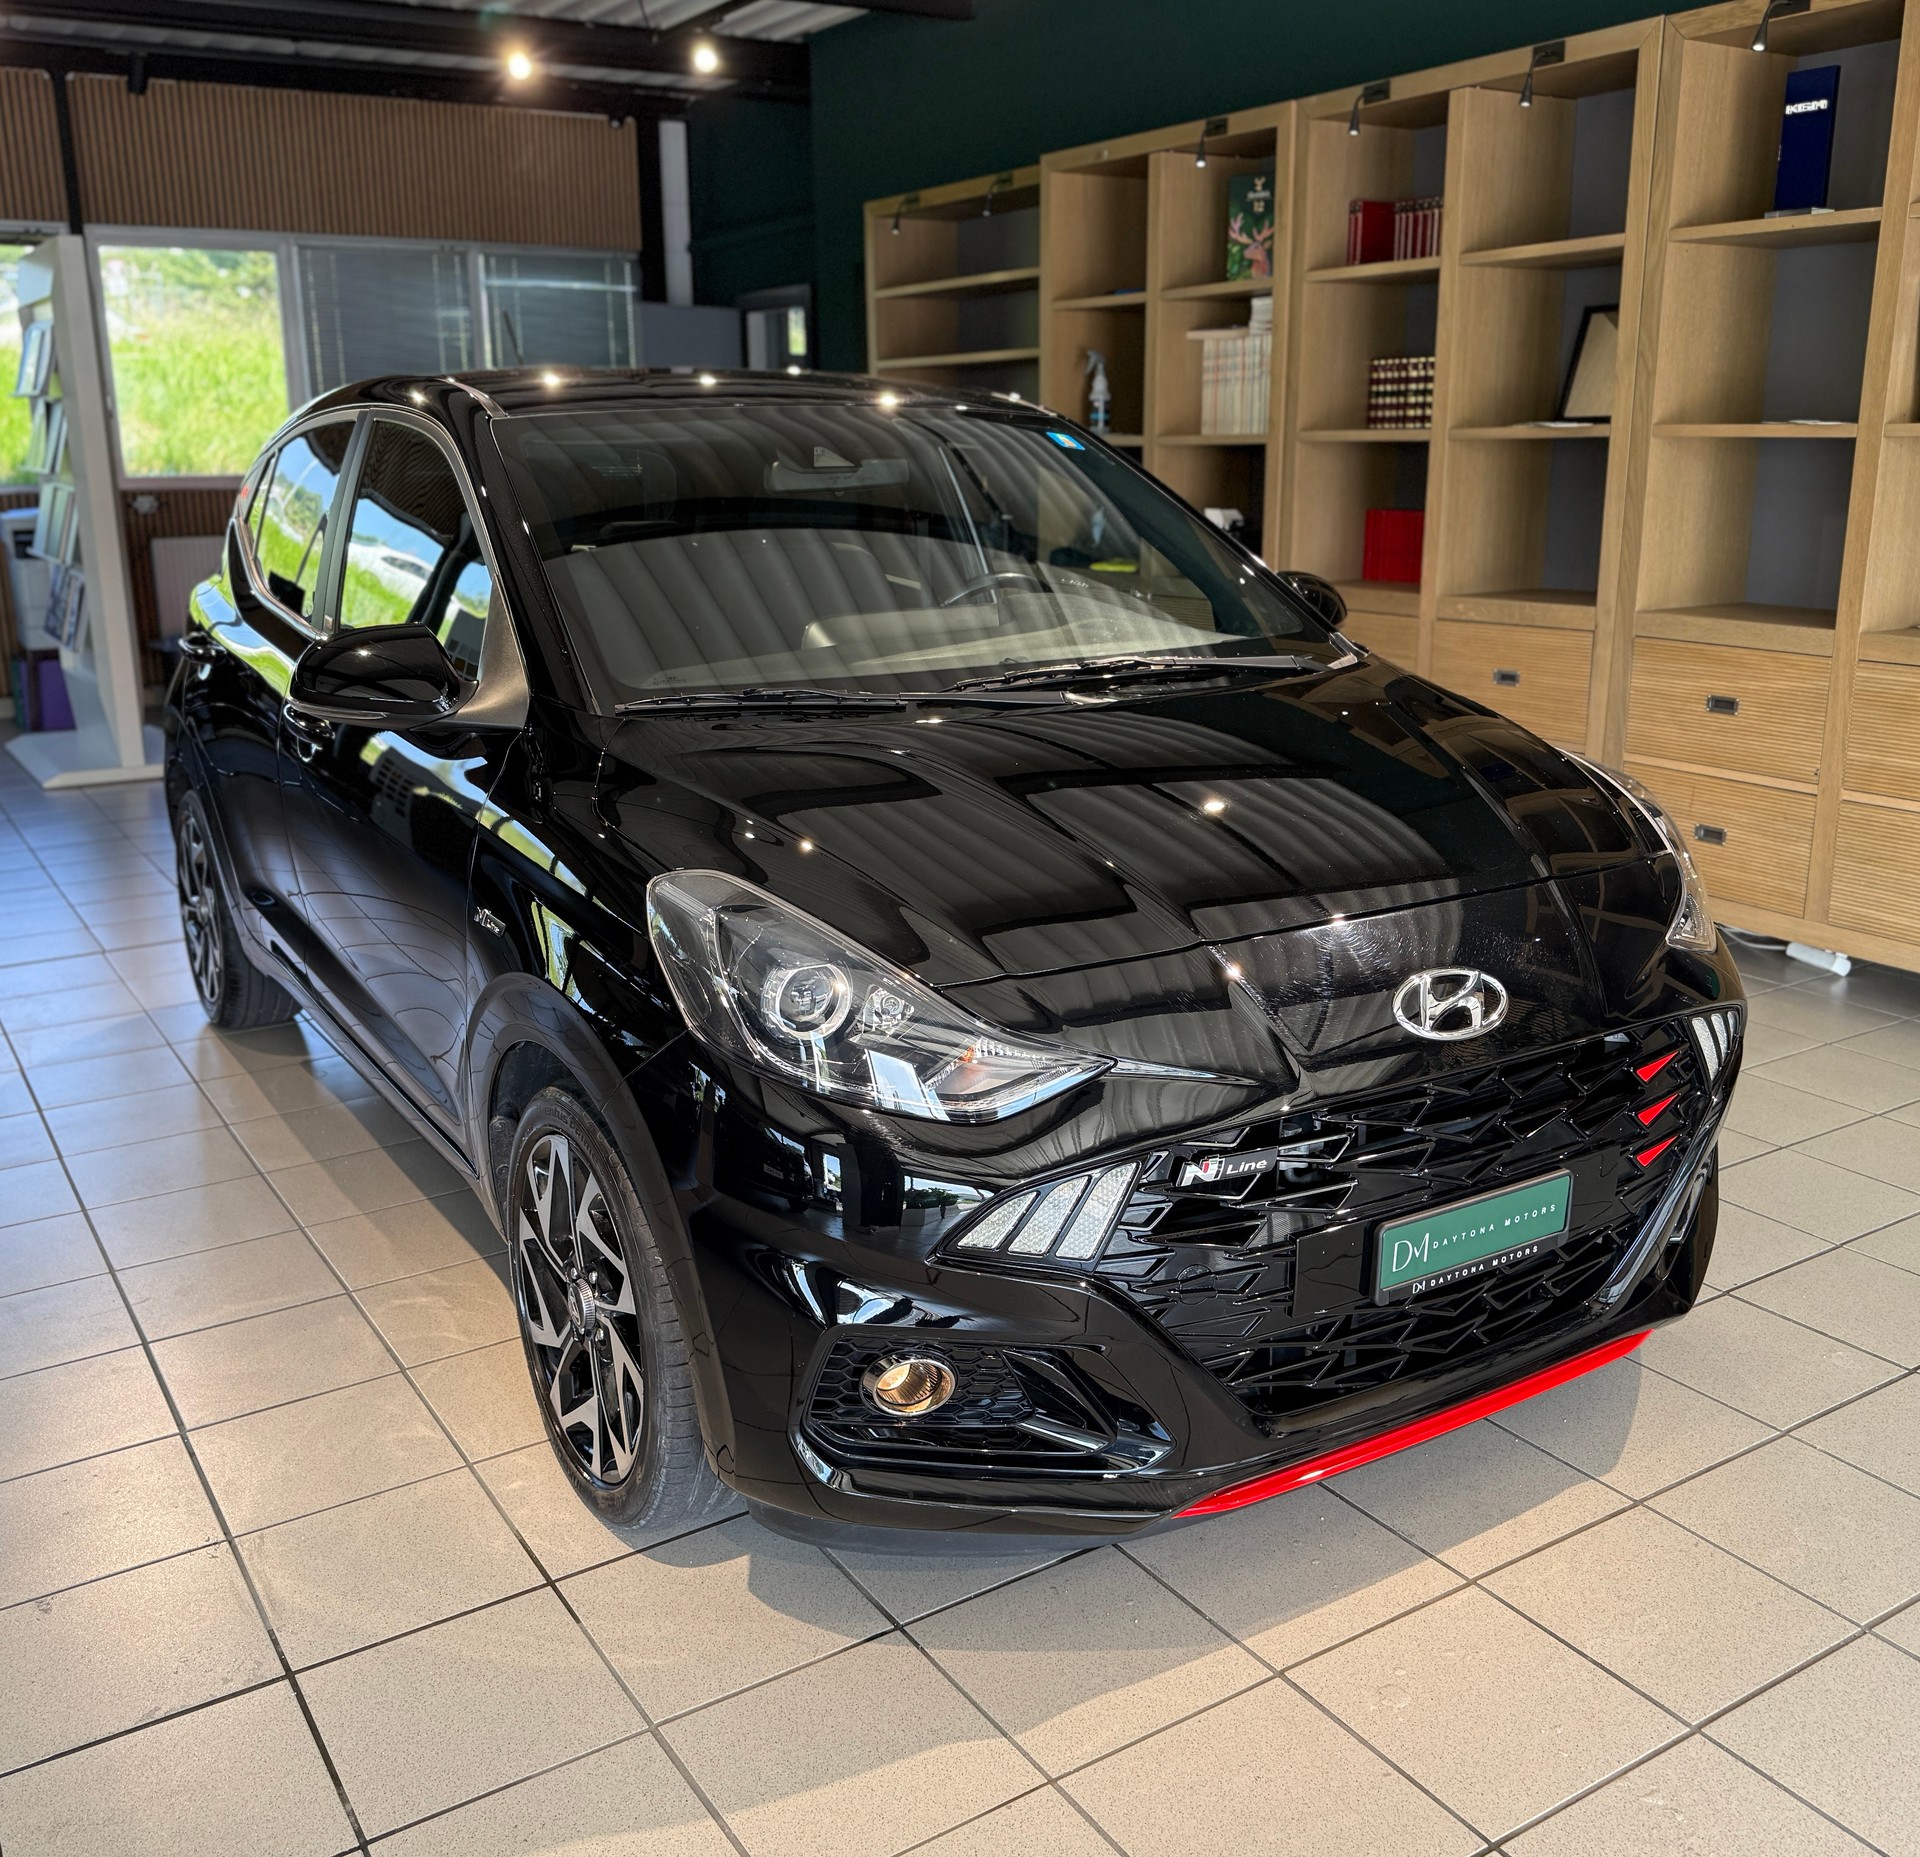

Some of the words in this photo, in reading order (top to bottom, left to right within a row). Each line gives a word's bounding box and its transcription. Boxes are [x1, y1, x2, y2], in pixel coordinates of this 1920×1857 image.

[1226, 1159, 1268, 1175] Line
[1432, 1223, 1495, 1249] DAYTONA
[1504, 1203, 1557, 1226] MOTORS
[1430, 1263, 1485, 1287] DAYTONA
[1492, 1245, 1539, 1266] MOTORS
